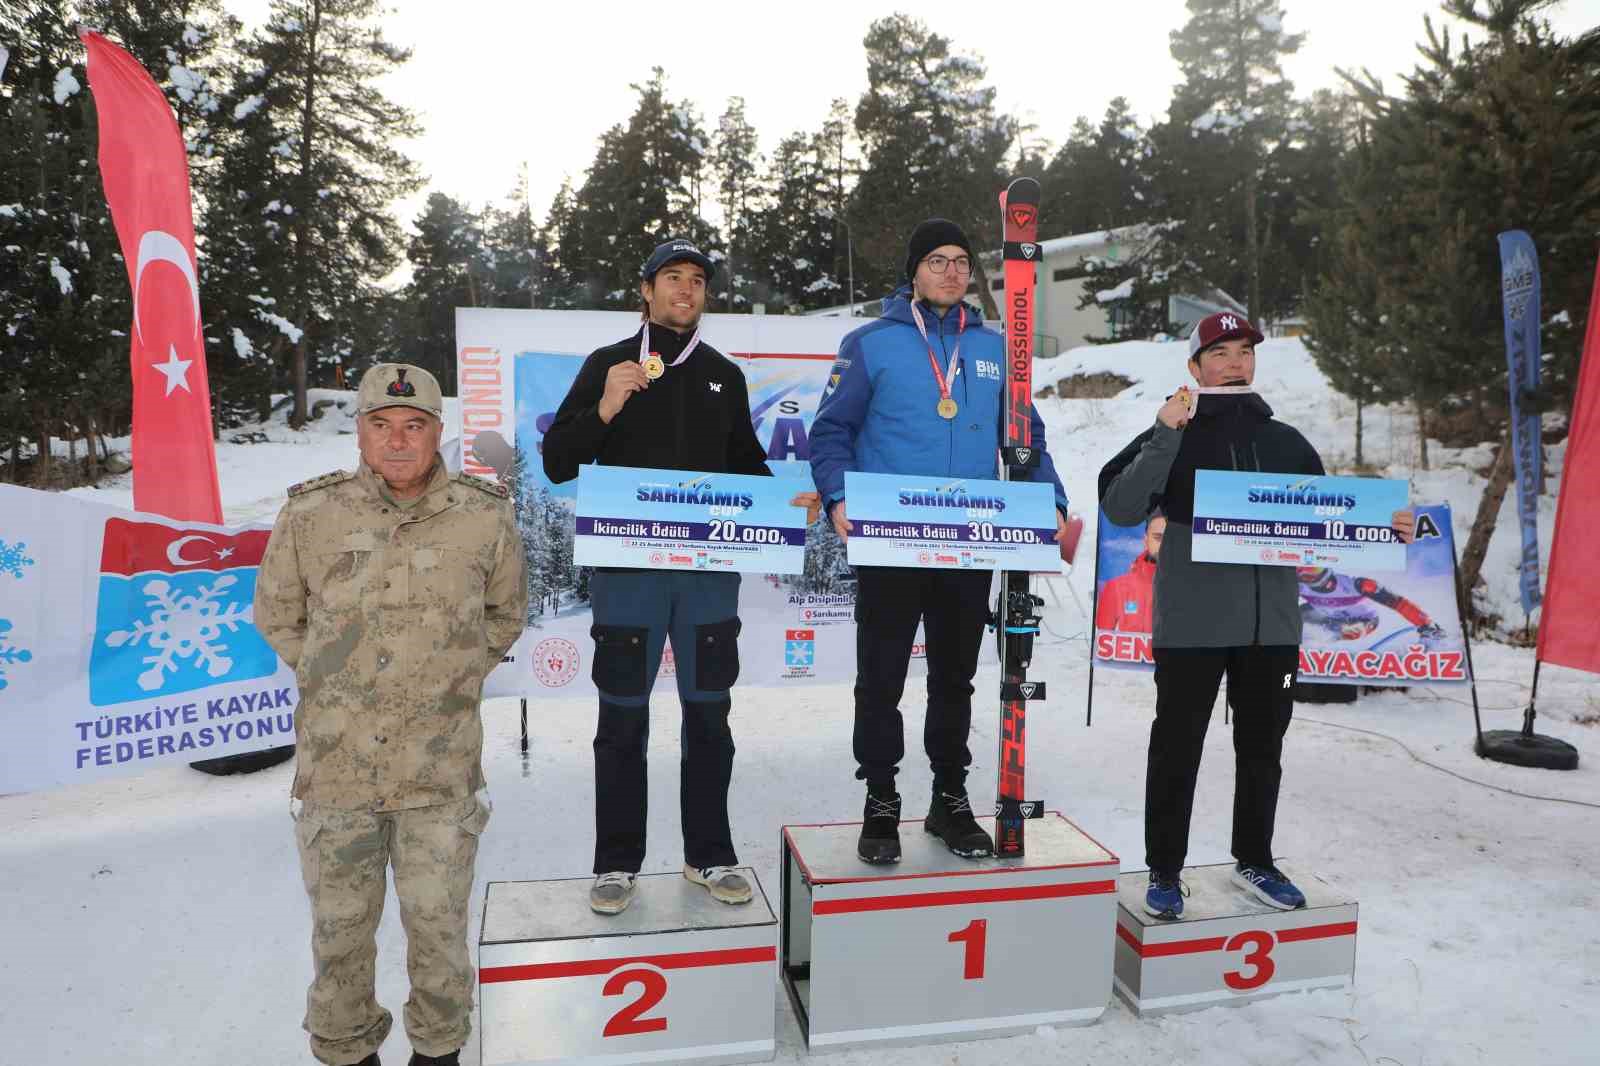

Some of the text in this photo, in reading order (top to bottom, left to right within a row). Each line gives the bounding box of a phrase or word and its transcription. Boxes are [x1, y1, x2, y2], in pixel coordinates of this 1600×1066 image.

[1014, 287, 1028, 382] ROSSIGNOL
[592, 522, 648, 537] İkincilik
[651, 523, 690, 539] Ödülü
[862, 524, 919, 538] Birincilik
[922, 525, 958, 540] Ödülü
[1206, 520, 1270, 535] Üçüncülük
[1274, 521, 1309, 537] Ödülü
[788, 595, 805, 606] Alp
[808, 594, 850, 605] Disiplinli
[75, 687, 293, 742] TÜRKİYE KAYAK
[76, 713, 294, 769] FEDERASYONU
[948, 918, 987, 979] 1
[1222, 930, 1276, 990] 3
[602, 968, 668, 1038] 2
